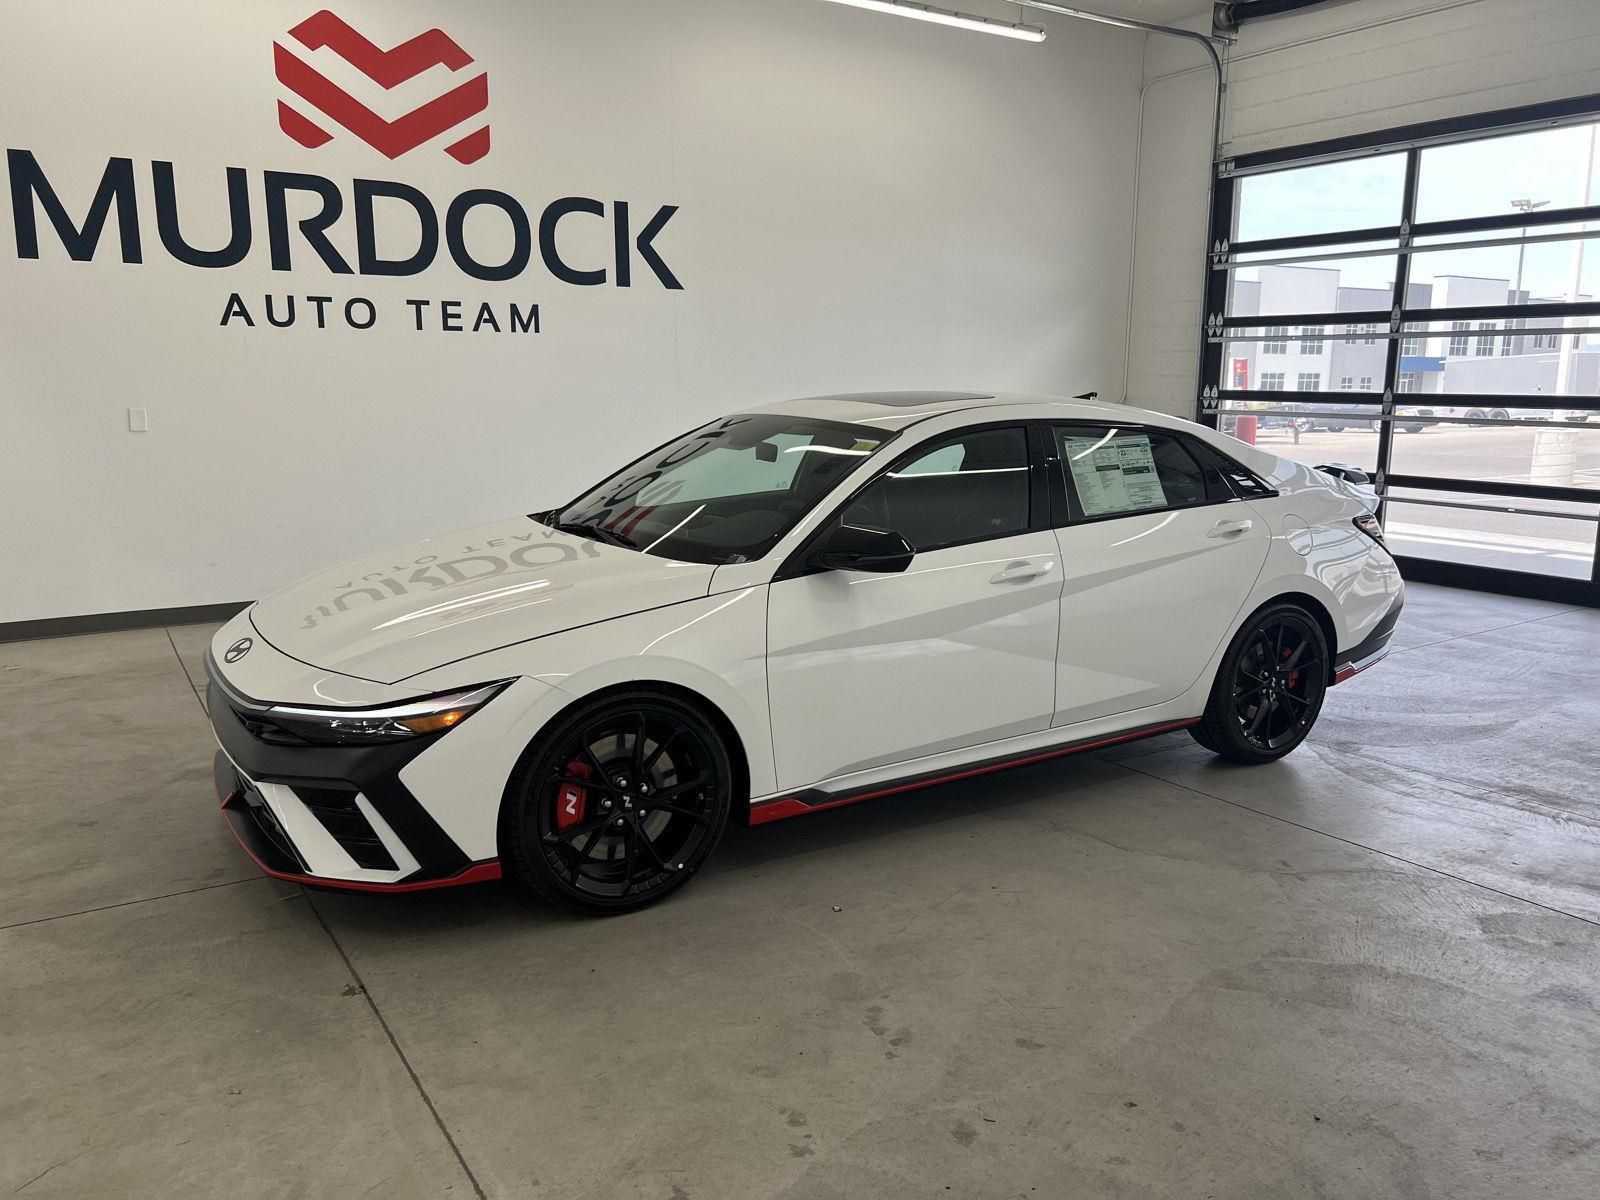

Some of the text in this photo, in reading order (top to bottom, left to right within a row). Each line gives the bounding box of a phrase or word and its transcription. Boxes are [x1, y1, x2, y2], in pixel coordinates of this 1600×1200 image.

[7, 148, 685, 290] MURDOCK
[220, 292, 540, 334] AUTO TEAM
